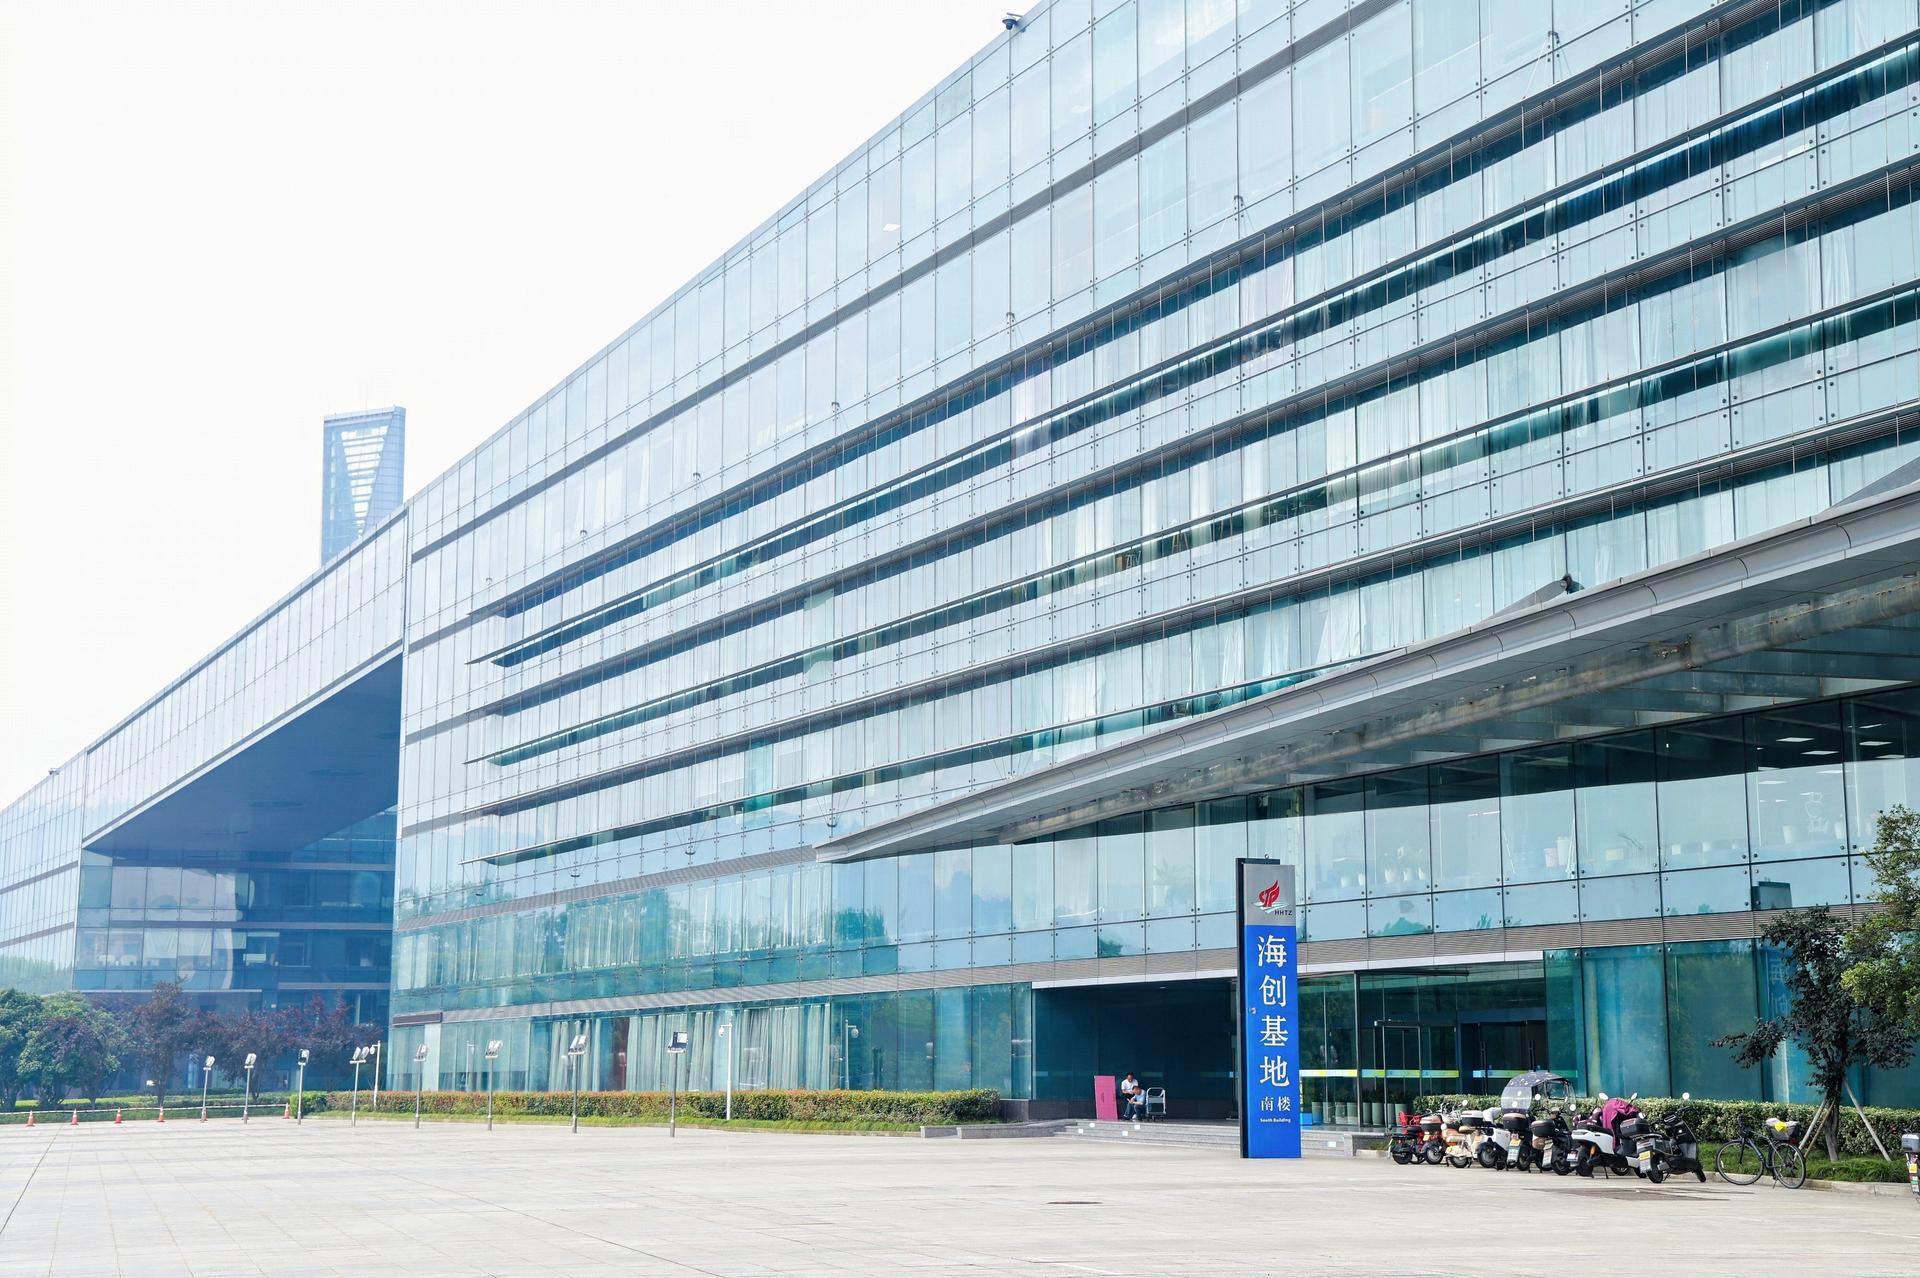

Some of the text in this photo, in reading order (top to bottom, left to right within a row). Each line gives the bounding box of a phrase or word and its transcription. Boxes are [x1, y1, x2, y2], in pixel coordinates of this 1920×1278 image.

[1258, 934, 1290, 1087] 海创基地
[1261, 1096, 1291, 1111] 南楼
